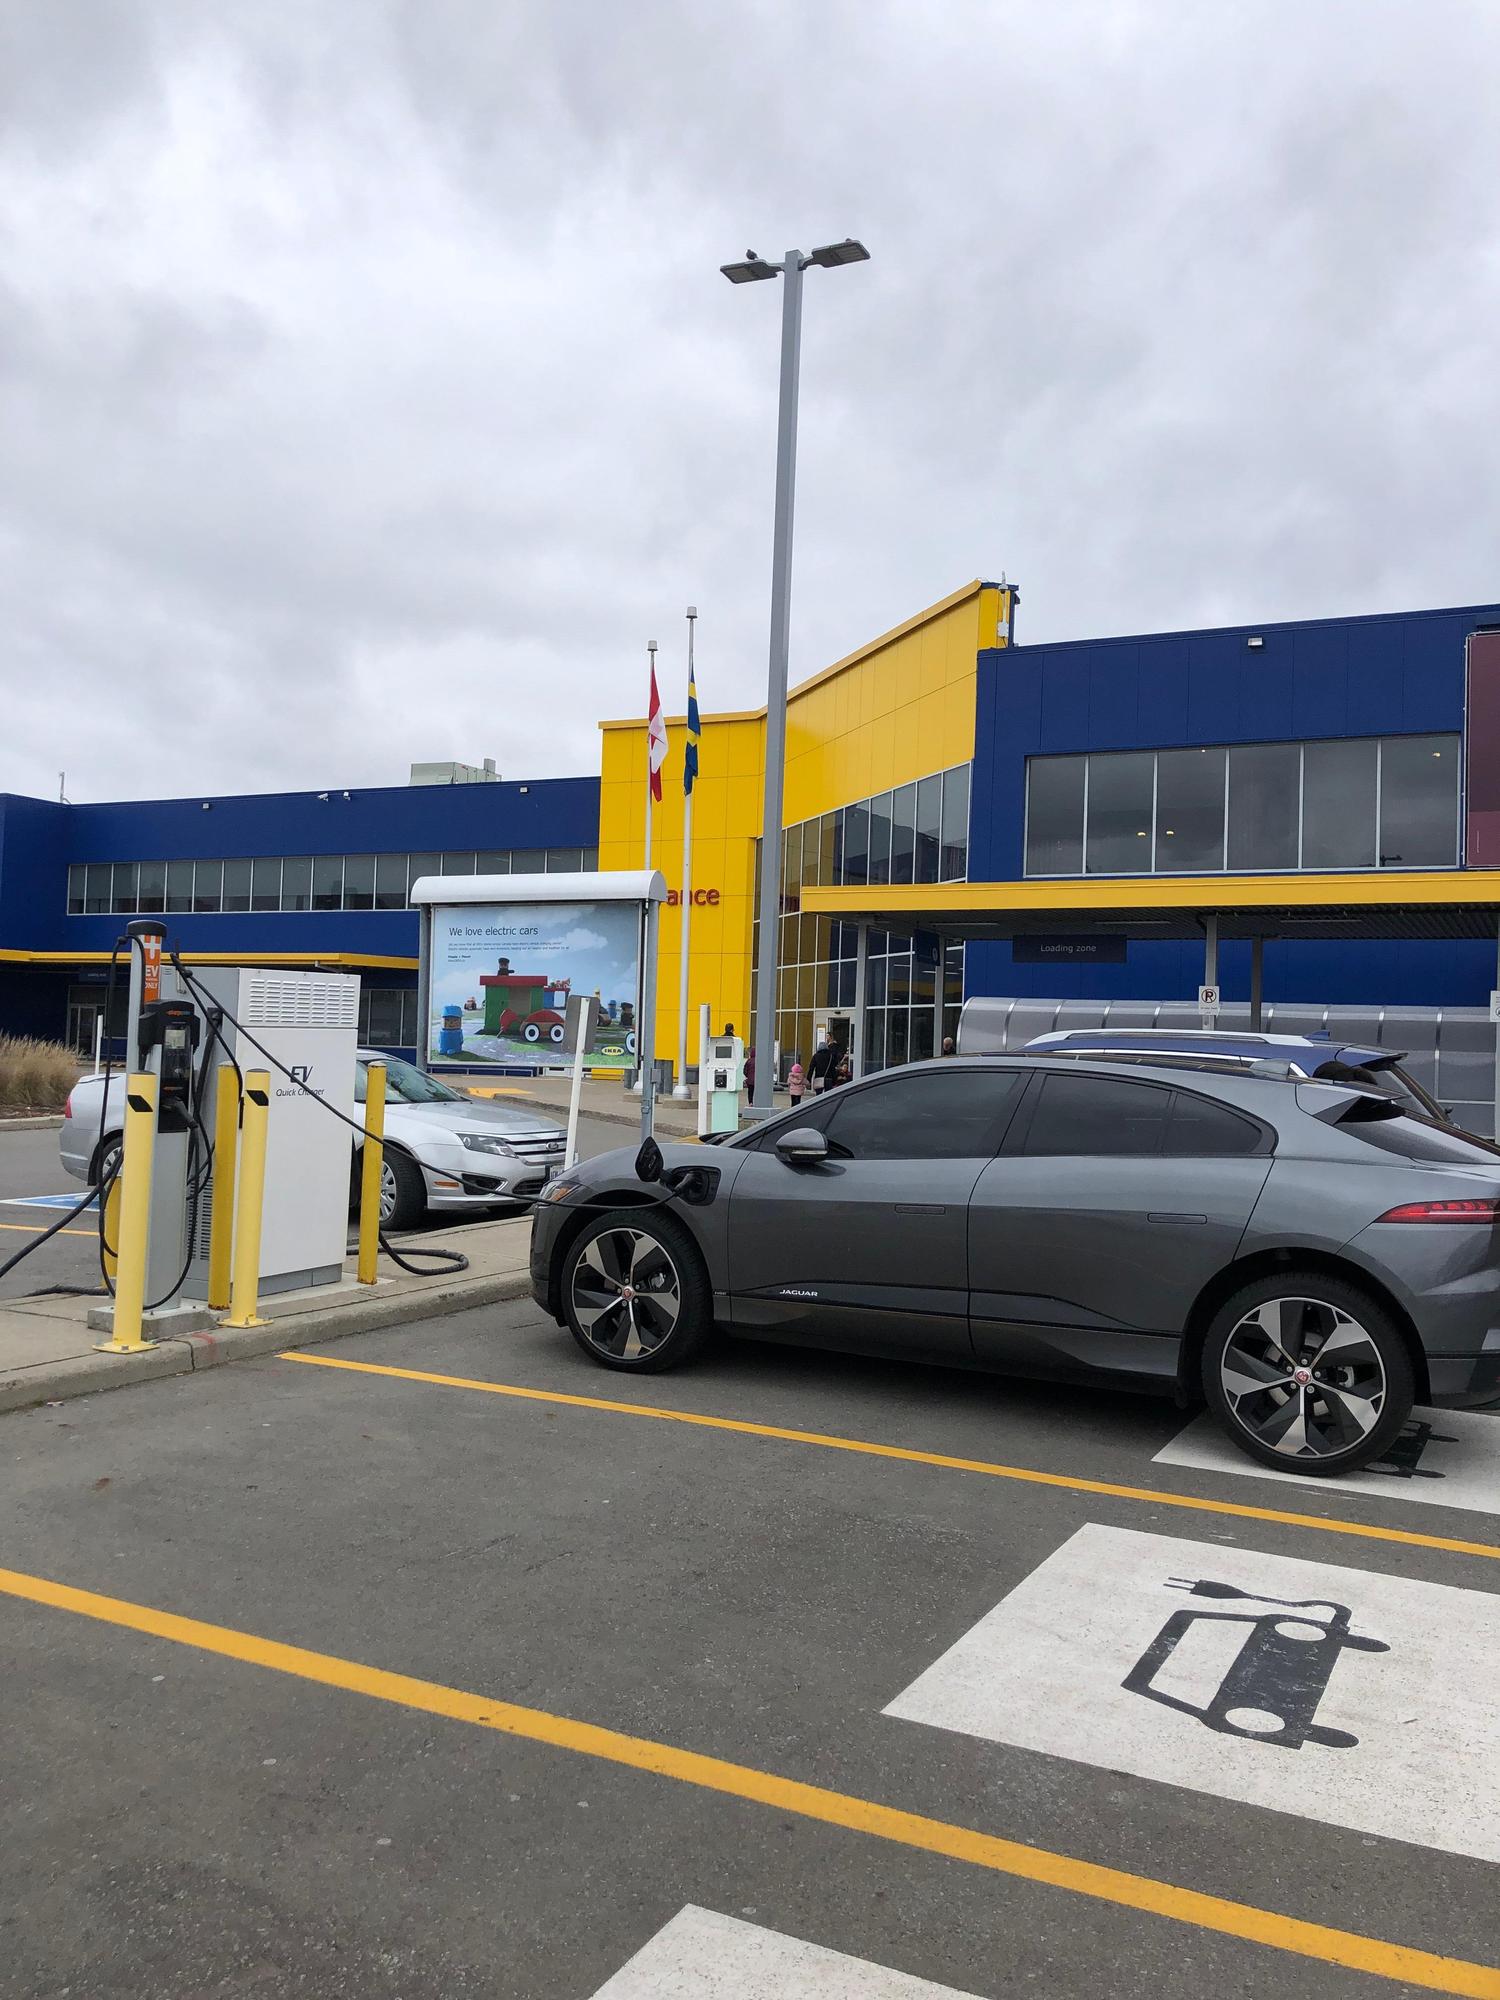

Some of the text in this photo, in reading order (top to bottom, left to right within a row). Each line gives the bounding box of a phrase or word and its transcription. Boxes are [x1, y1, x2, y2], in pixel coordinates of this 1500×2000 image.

[449, 926, 539, 936] We love electric cars
[1040, 944, 1074, 954] Loading
[145, 965, 159, 977] EV
[290, 1066, 314, 1083] EV
[276, 1088, 325, 1097] Quick Chger
